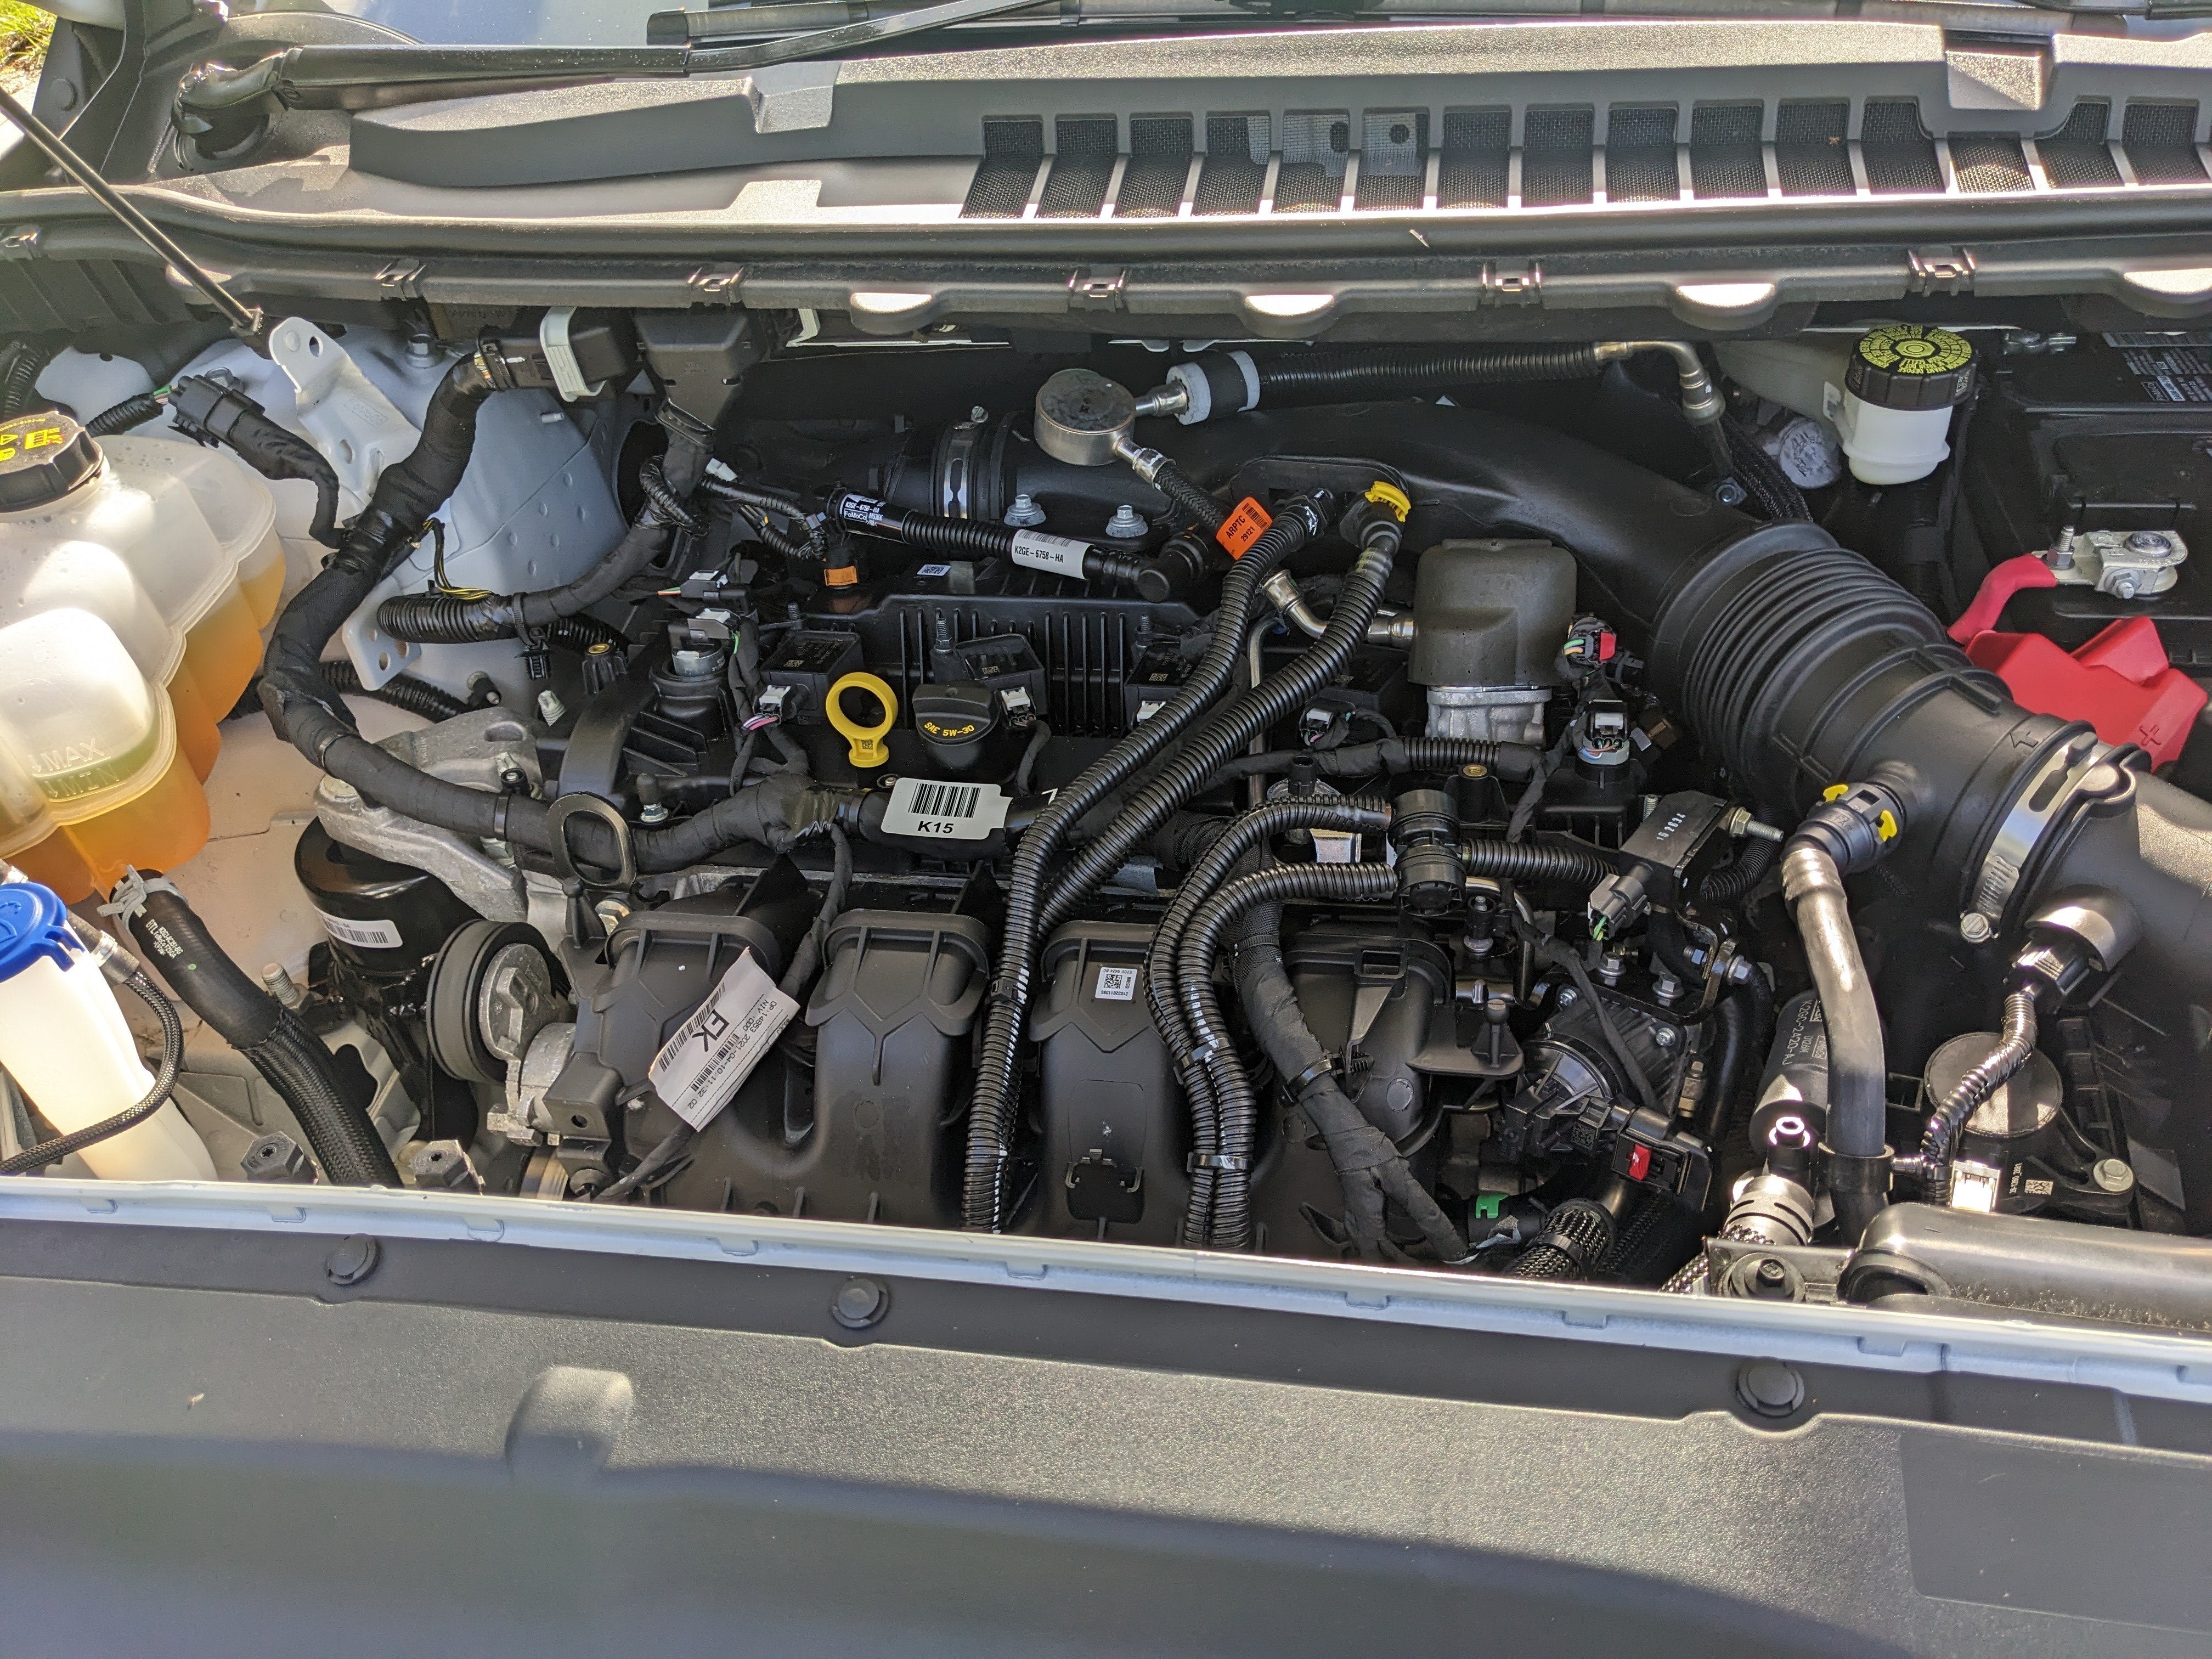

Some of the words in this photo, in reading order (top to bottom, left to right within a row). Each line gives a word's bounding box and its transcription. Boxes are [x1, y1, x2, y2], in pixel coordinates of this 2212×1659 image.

[845, 510, 867, 521] FoMoCo
[1226, 515, 1245, 539] ARPTC
[1240, 526, 1255, 542] 29121
[924, 722, 940, 734] SAE
[943, 725, 975, 737] 5W-30
[41, 738, 105, 771] MAX
[57, 764, 120, 797] MIN
[917, 820, 954, 834] K15
[145, 918, 159, 934] BTL
[757, 999, 770, 1014] NIV
[691, 1008, 730, 1052] EK
